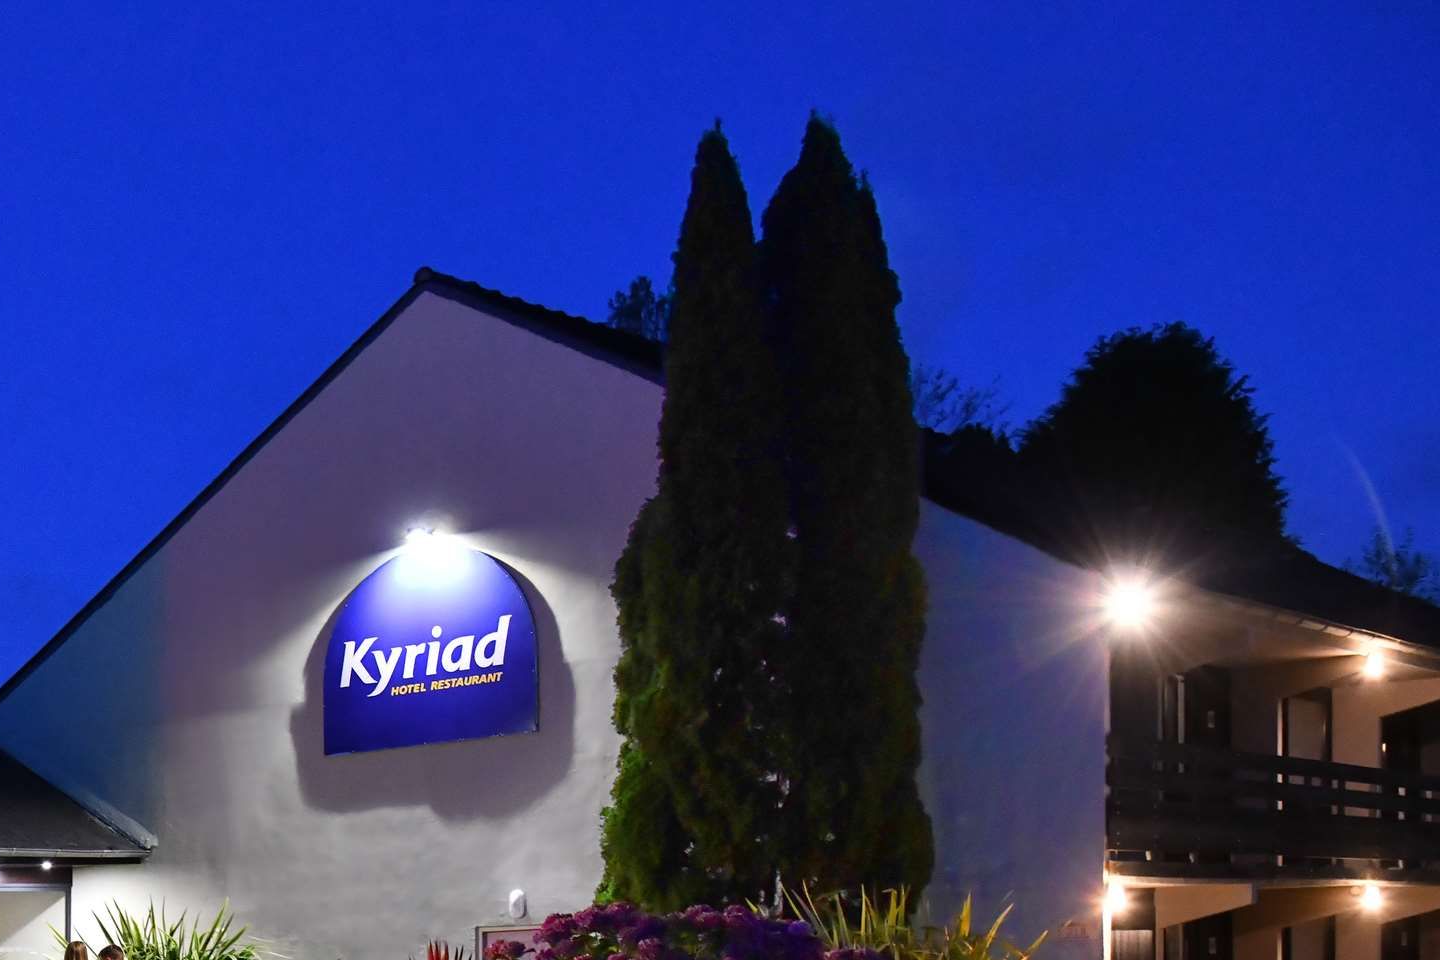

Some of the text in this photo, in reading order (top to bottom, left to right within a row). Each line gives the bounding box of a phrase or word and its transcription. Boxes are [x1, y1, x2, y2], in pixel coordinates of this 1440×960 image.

[340, 614, 512, 698] Kyriad
[391, 671, 503, 697] HOTEL RESTAURANT
